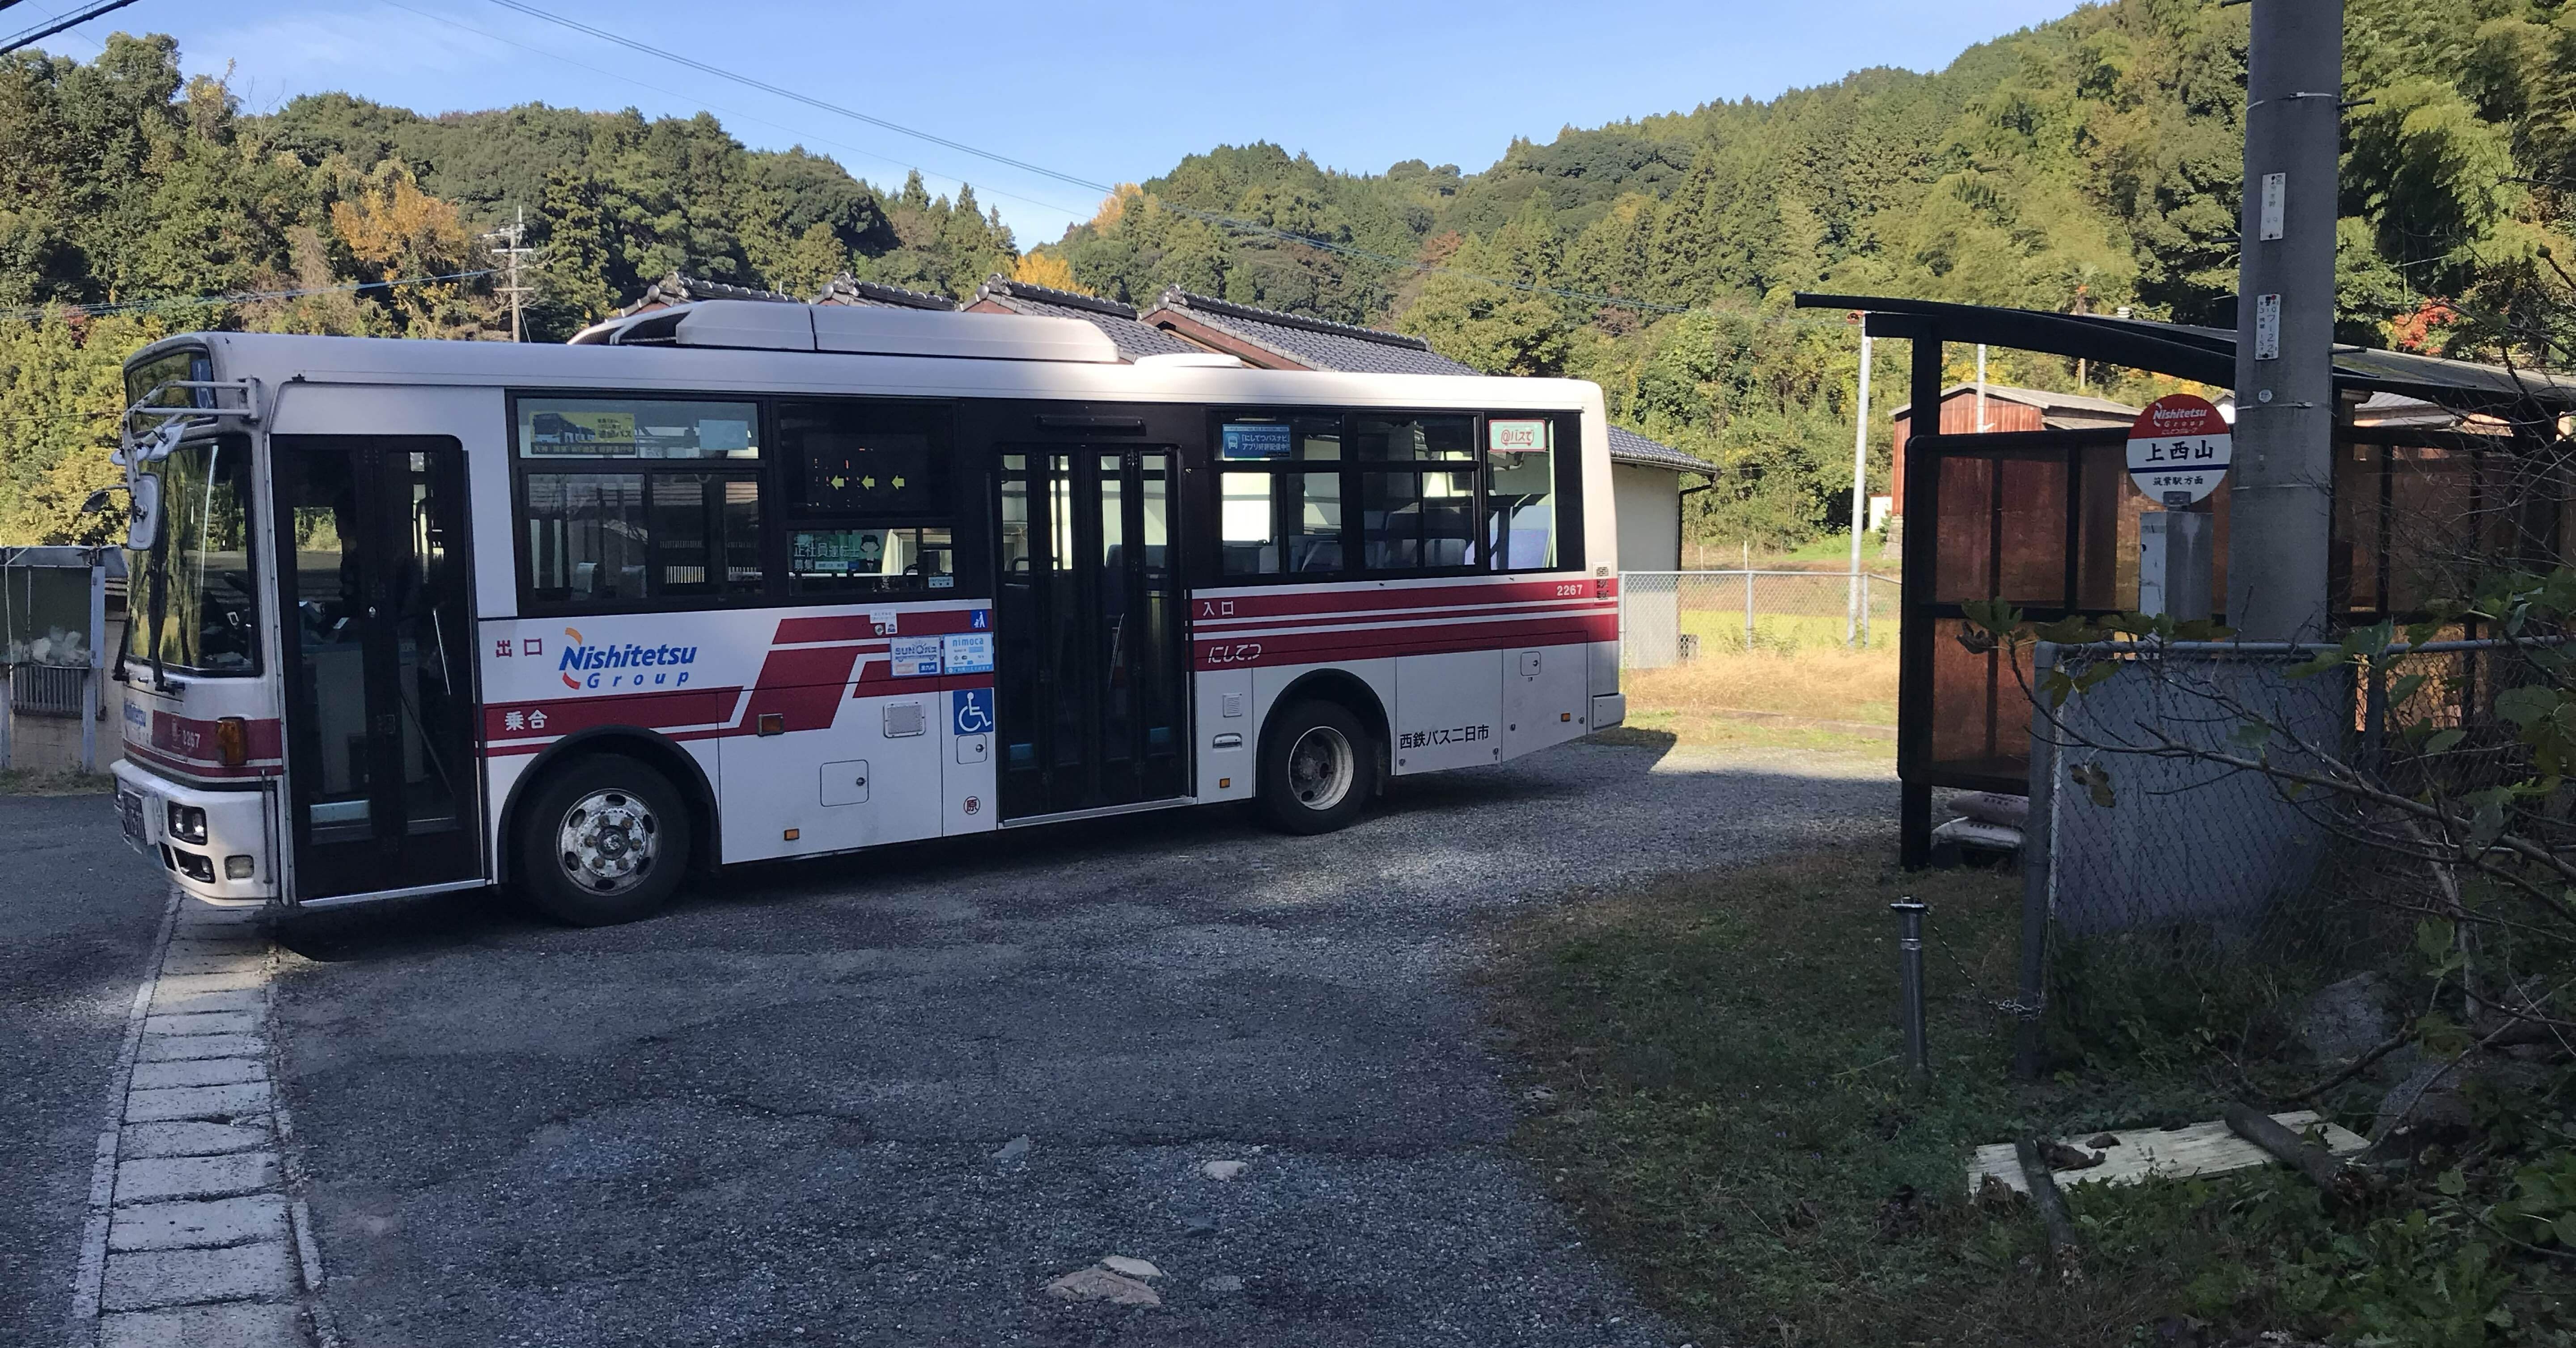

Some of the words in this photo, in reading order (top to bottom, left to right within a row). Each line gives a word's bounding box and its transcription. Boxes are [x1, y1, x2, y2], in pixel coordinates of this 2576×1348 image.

[2152, 409, 2207, 419] Nishitetsu
[2145, 440, 2214, 461] 上西山
[2152, 476, 2203, 486] 筑紫駅方面
[1557, 584, 1583, 596] 2267
[1203, 600, 1233, 616] 入口
[496, 638, 542, 657] 出口
[952, 638, 983, 647] nimoca
[559, 644, 697, 671] Nishitetsu
[1208, 643, 1262, 663] にしてつ
[587, 672, 689, 689] Group
[505, 709, 547, 731] 乗合
[1400, 724, 1489, 749] 西鉄バス二日市
